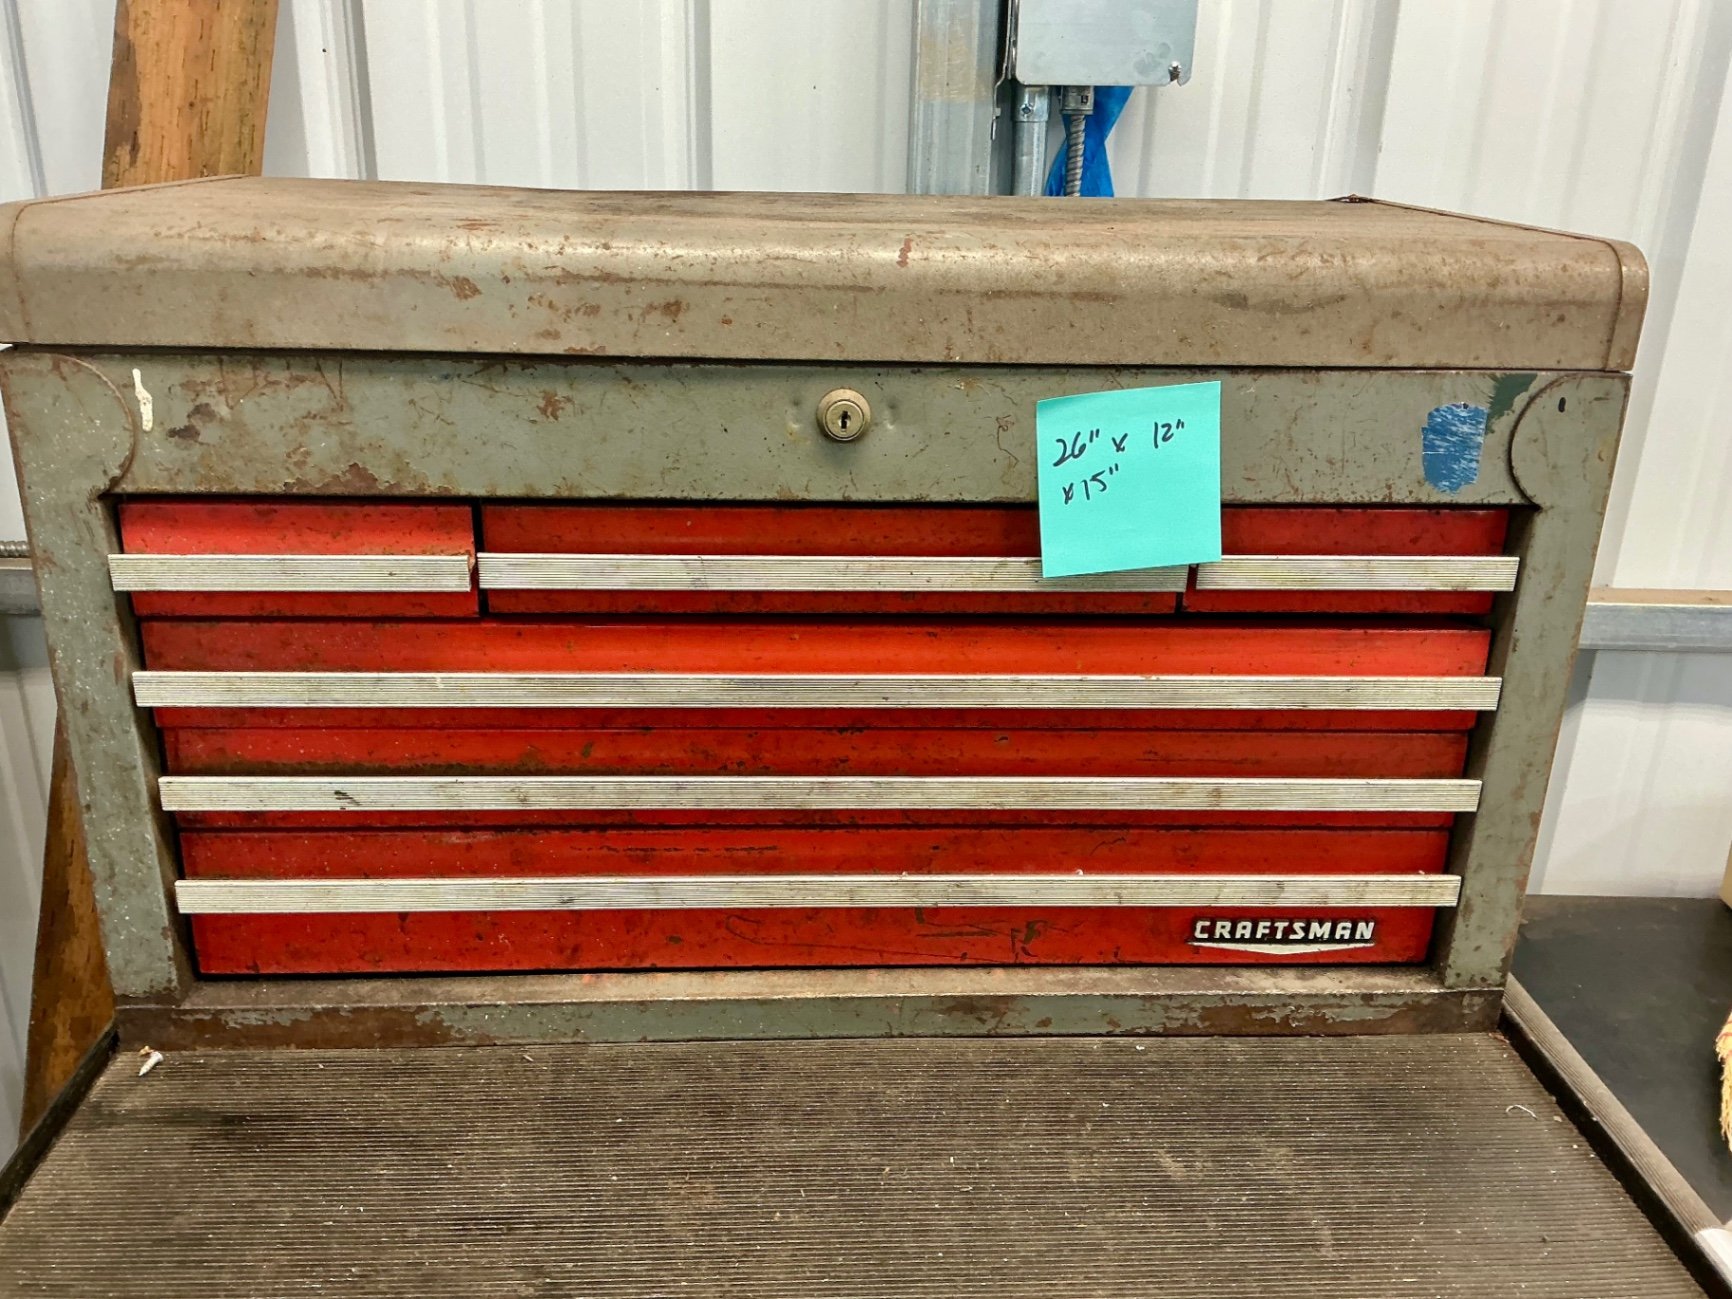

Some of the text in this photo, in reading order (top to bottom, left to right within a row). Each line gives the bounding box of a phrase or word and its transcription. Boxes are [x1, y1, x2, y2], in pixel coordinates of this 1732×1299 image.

[1053, 428, 1100, 467] 26"
[1153, 418, 1185, 449] 12"
[1193, 920, 1376, 940] CRAFTSMAN
